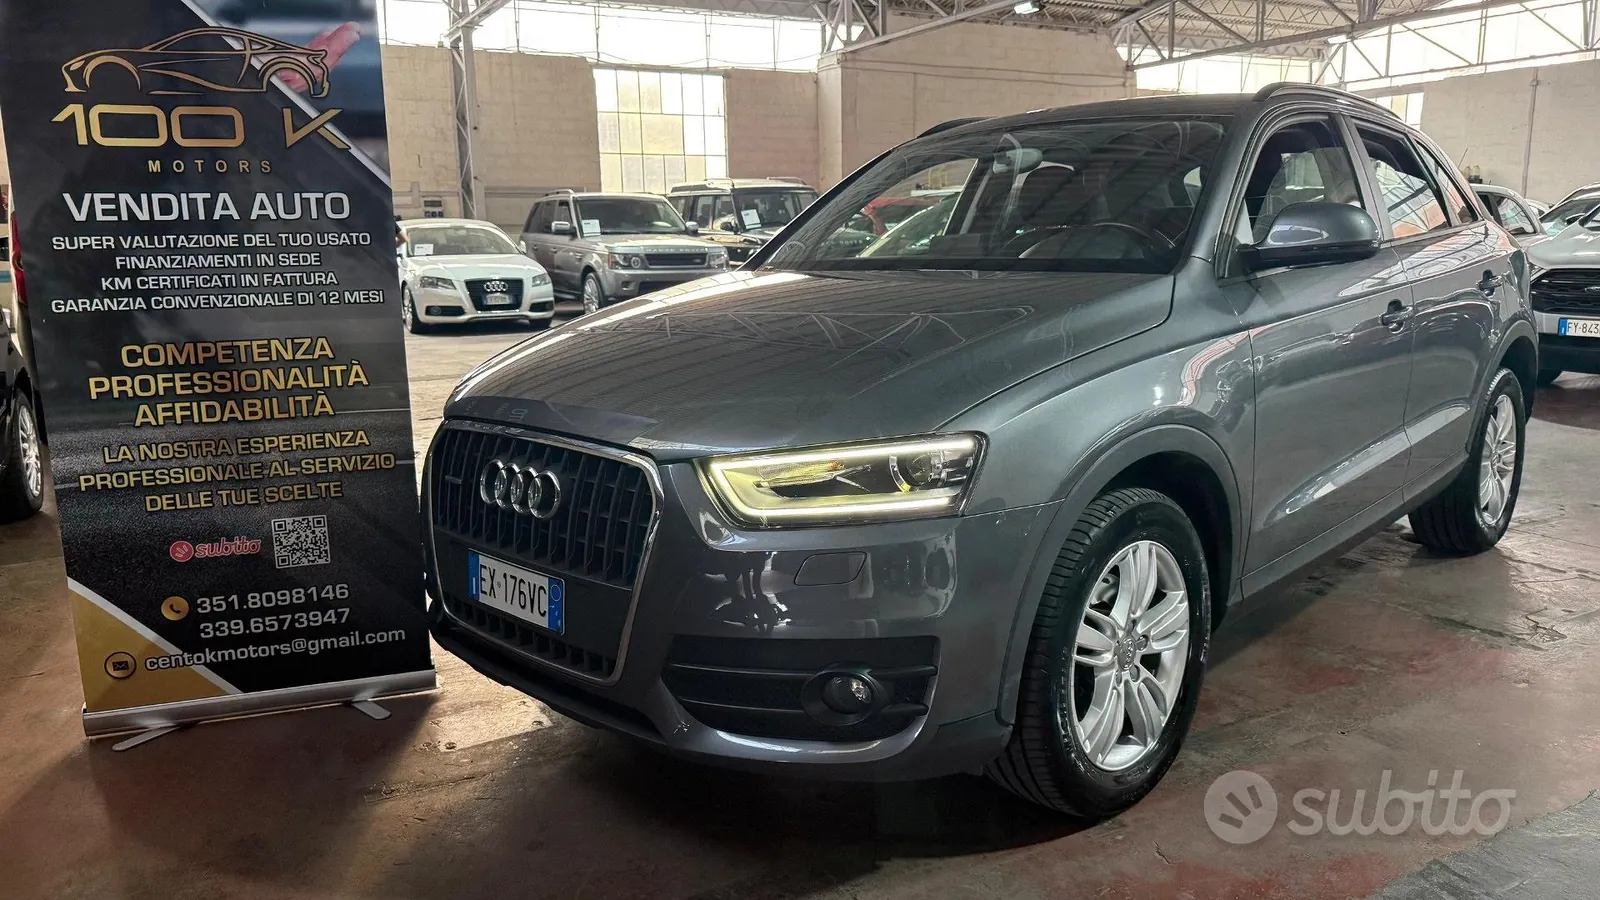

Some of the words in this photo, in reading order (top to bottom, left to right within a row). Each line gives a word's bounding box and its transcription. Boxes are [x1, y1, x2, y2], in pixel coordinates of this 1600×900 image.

[51, 104, 245, 148] 100
[283, 107, 352, 150] K
[148, 160, 272, 173] MOTORS
[63, 193, 240, 222] VENDITA
[250, 192, 351, 220] AUTO
[52, 236, 115, 251] SUPER
[119, 234, 240, 250] VALUTAZIONE
[244, 233, 275, 247] DEL
[278, 232, 313, 246] TUO
[317, 232, 371, 246] USATO
[115, 253, 252, 270] FINANZIAMENTI
[257, 253, 275, 267] IN
[279, 253, 321, 266] SEDE
[101, 276, 133, 291] KM
[136, 274, 236, 290] CERTIFICATI
[241, 273, 259, 287] IN
[263, 272, 338, 286] FATTURA
[51, 297, 147, 314] GARANZIA
[150, 294, 293, 310] CONVENZIONALE
[297, 292, 314, 305] DI
[318, 291, 340, 305] 12
[344, 290, 384, 304] MESI
[1582, 322, 1600, 334] 843
[121, 337, 334, 368] COMPETENZA
[88, 360, 369, 400] PROFESSIONALITÀ
[134, 390, 335, 427] AFFIDABILITÀ
[103, 445, 134, 464] LA
[138, 439, 234, 462] NOSTRA
[237, 430, 370, 455] ESPERIENZA
[79, 463, 264, 492] PROFESSIONALE
[268, 460, 298, 478] AL
[301, 453, 396, 476] SERVIZIO
[145, 490, 214, 513] DELLE
[217, 487, 262, 507] TUE
[265, 482, 343, 502] SCELTE
[194, 537, 262, 559] subito
[196, 583, 350, 614] 351.8098146
[200, 608, 351, 639] 339.6573947
[144, 628, 406, 671] centokmotors@gmail.com
